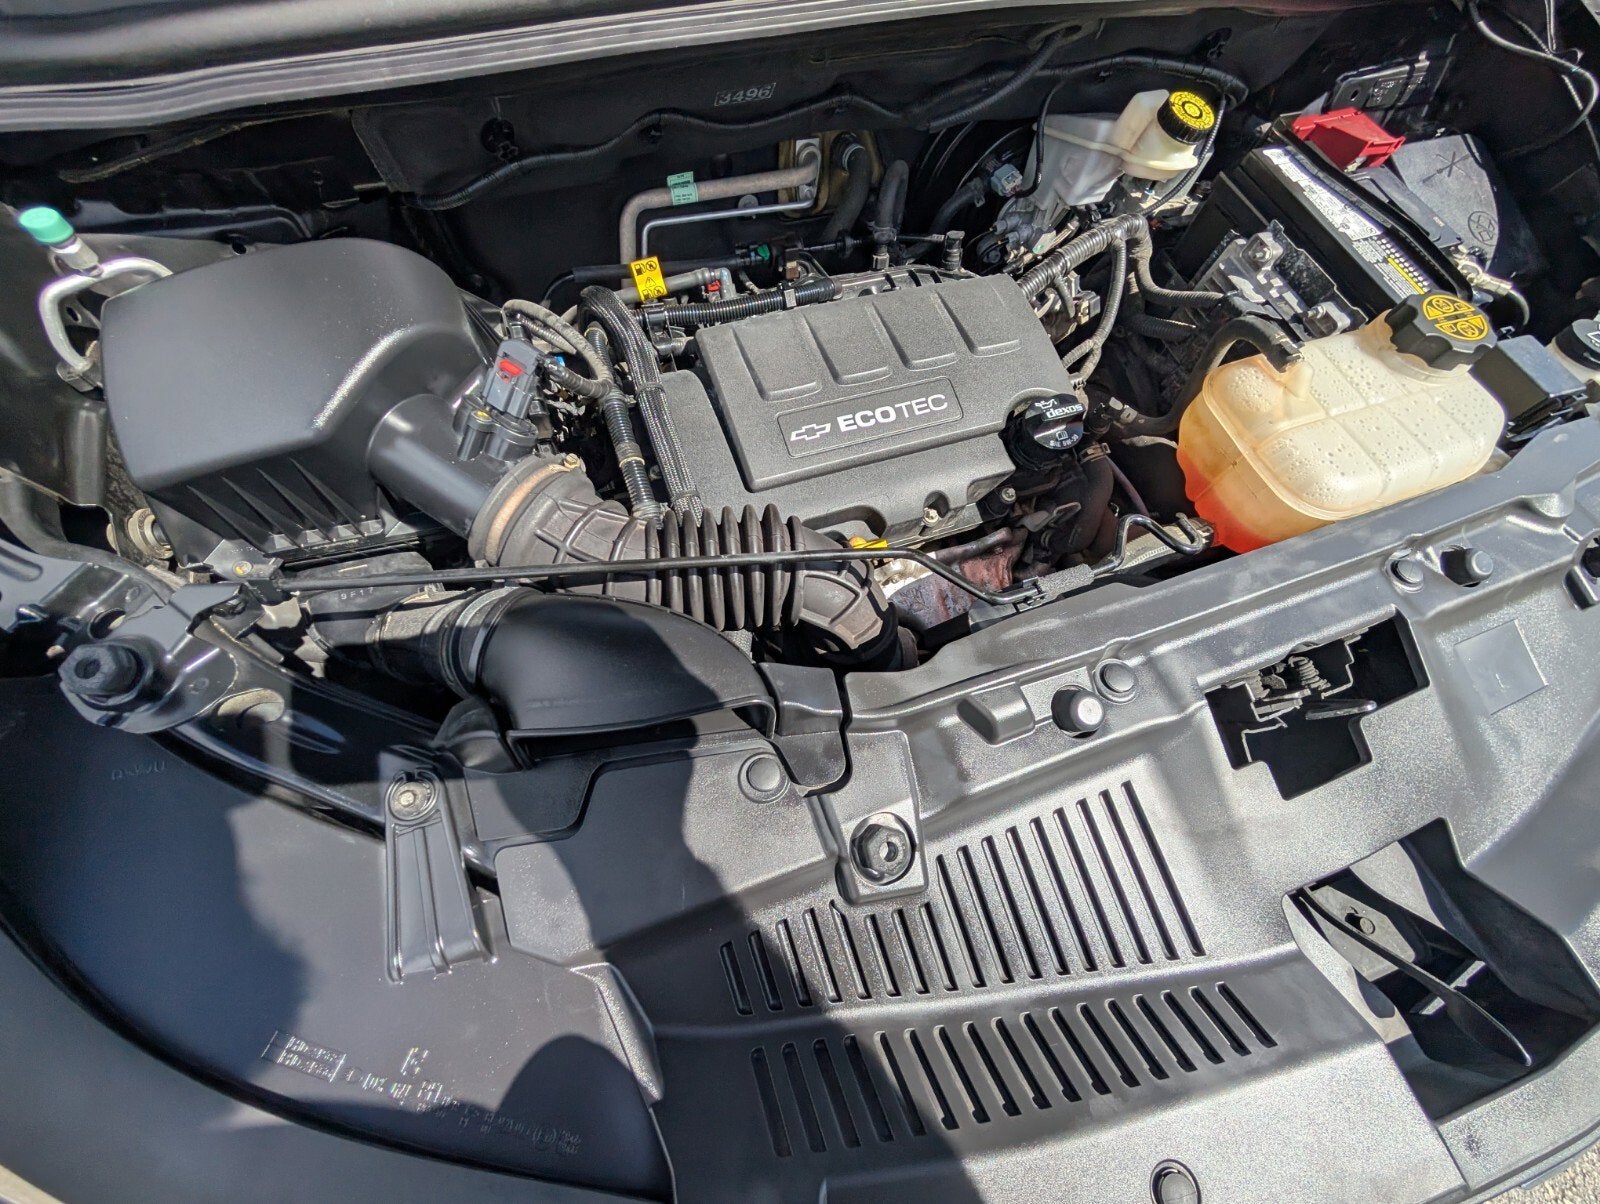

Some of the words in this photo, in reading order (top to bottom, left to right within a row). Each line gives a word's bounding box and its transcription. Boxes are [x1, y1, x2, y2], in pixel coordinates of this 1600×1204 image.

[718, 86, 772, 104] 3496
[836, 394, 948, 432] ECOTEC
[1046, 404, 1084, 418] dexos
